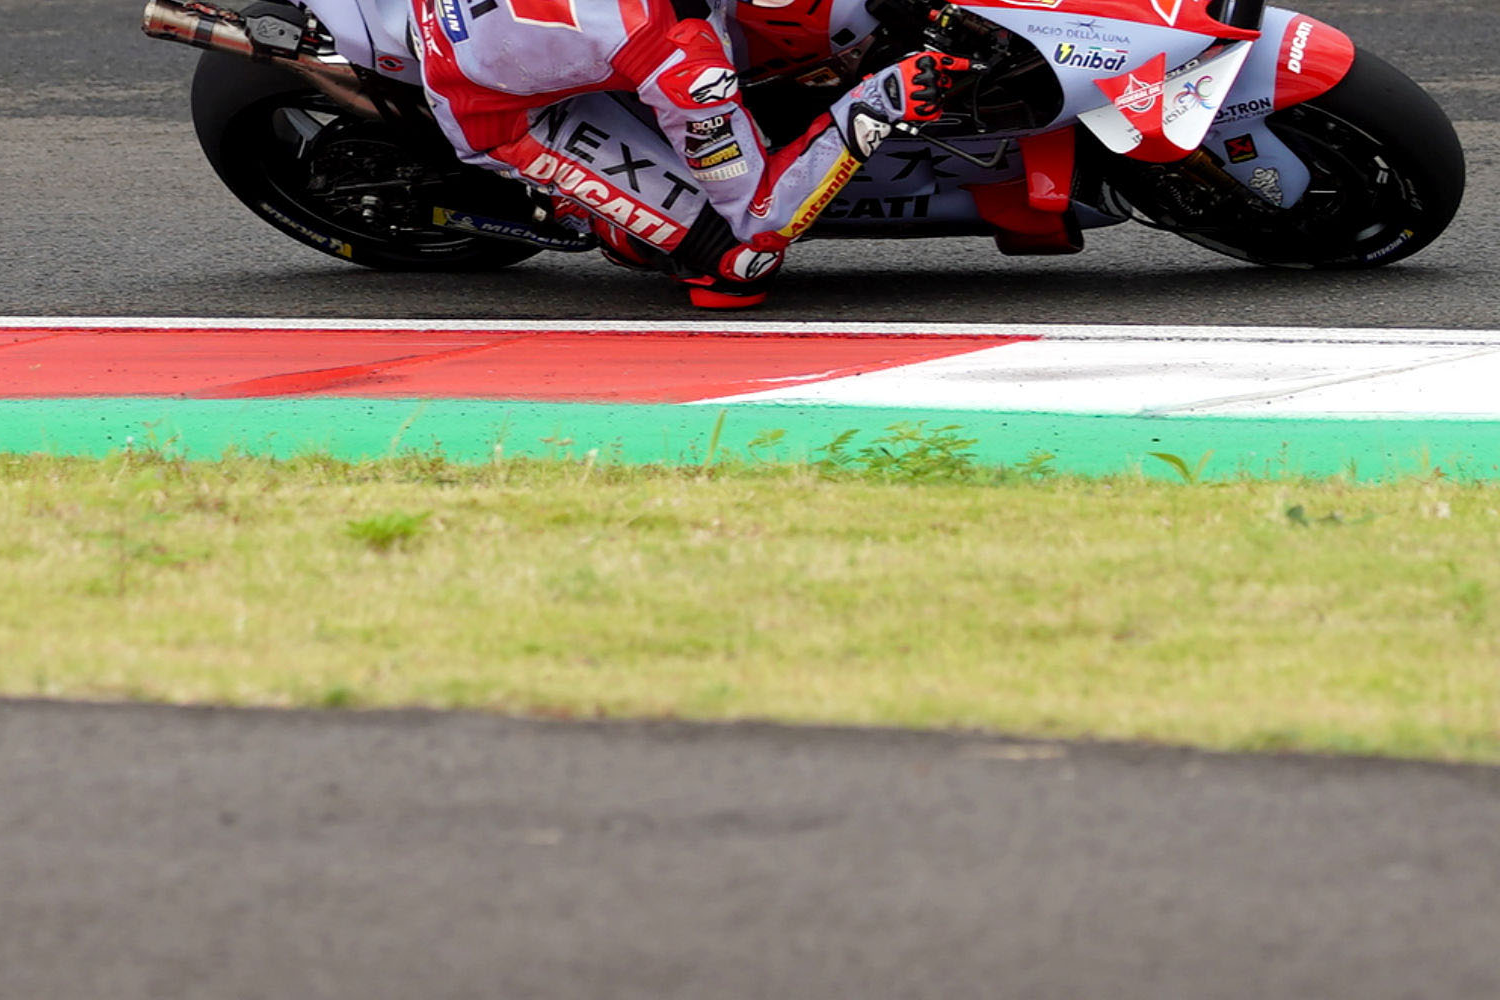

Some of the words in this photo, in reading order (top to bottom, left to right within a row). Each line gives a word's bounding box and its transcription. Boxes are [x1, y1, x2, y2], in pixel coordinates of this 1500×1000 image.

[1053, 42, 1128, 72] Unibat
[1066, 28, 1100, 41] DELLA
[1102, 33, 1131, 45] LUNA
[1287, 21, 1315, 74] DUCATI
[521, 152, 680, 245] DUCATI
